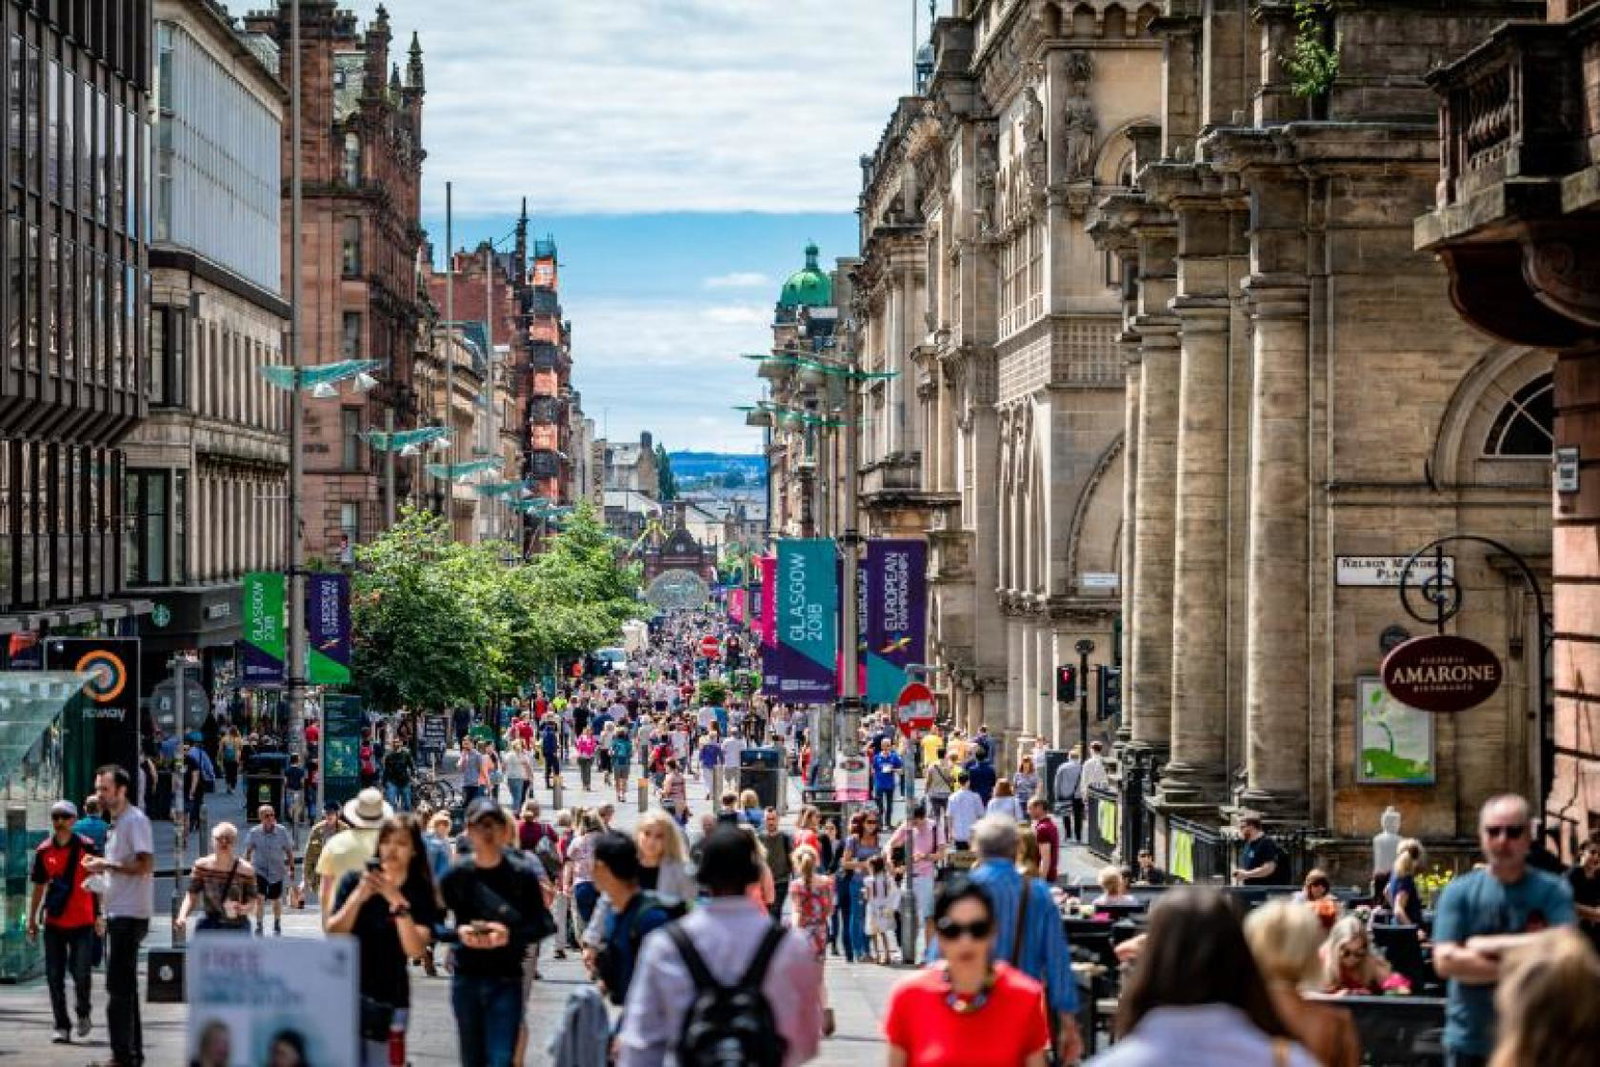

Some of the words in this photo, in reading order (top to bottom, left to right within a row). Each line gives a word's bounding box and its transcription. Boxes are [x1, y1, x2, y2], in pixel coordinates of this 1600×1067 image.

[253, 580, 264, 641] GLASGOW
[321, 580, 331, 635] EUROPEAN
[789, 553, 805, 641] GLASGOW
[884, 553, 898, 630] EUROPEAN
[898, 553, 909, 630] CHAMPIONSHIPS
[264, 615, 275, 641] 2018
[807, 603, 823, 641] 2018
[1392, 664, 1496, 685] AMARONE
